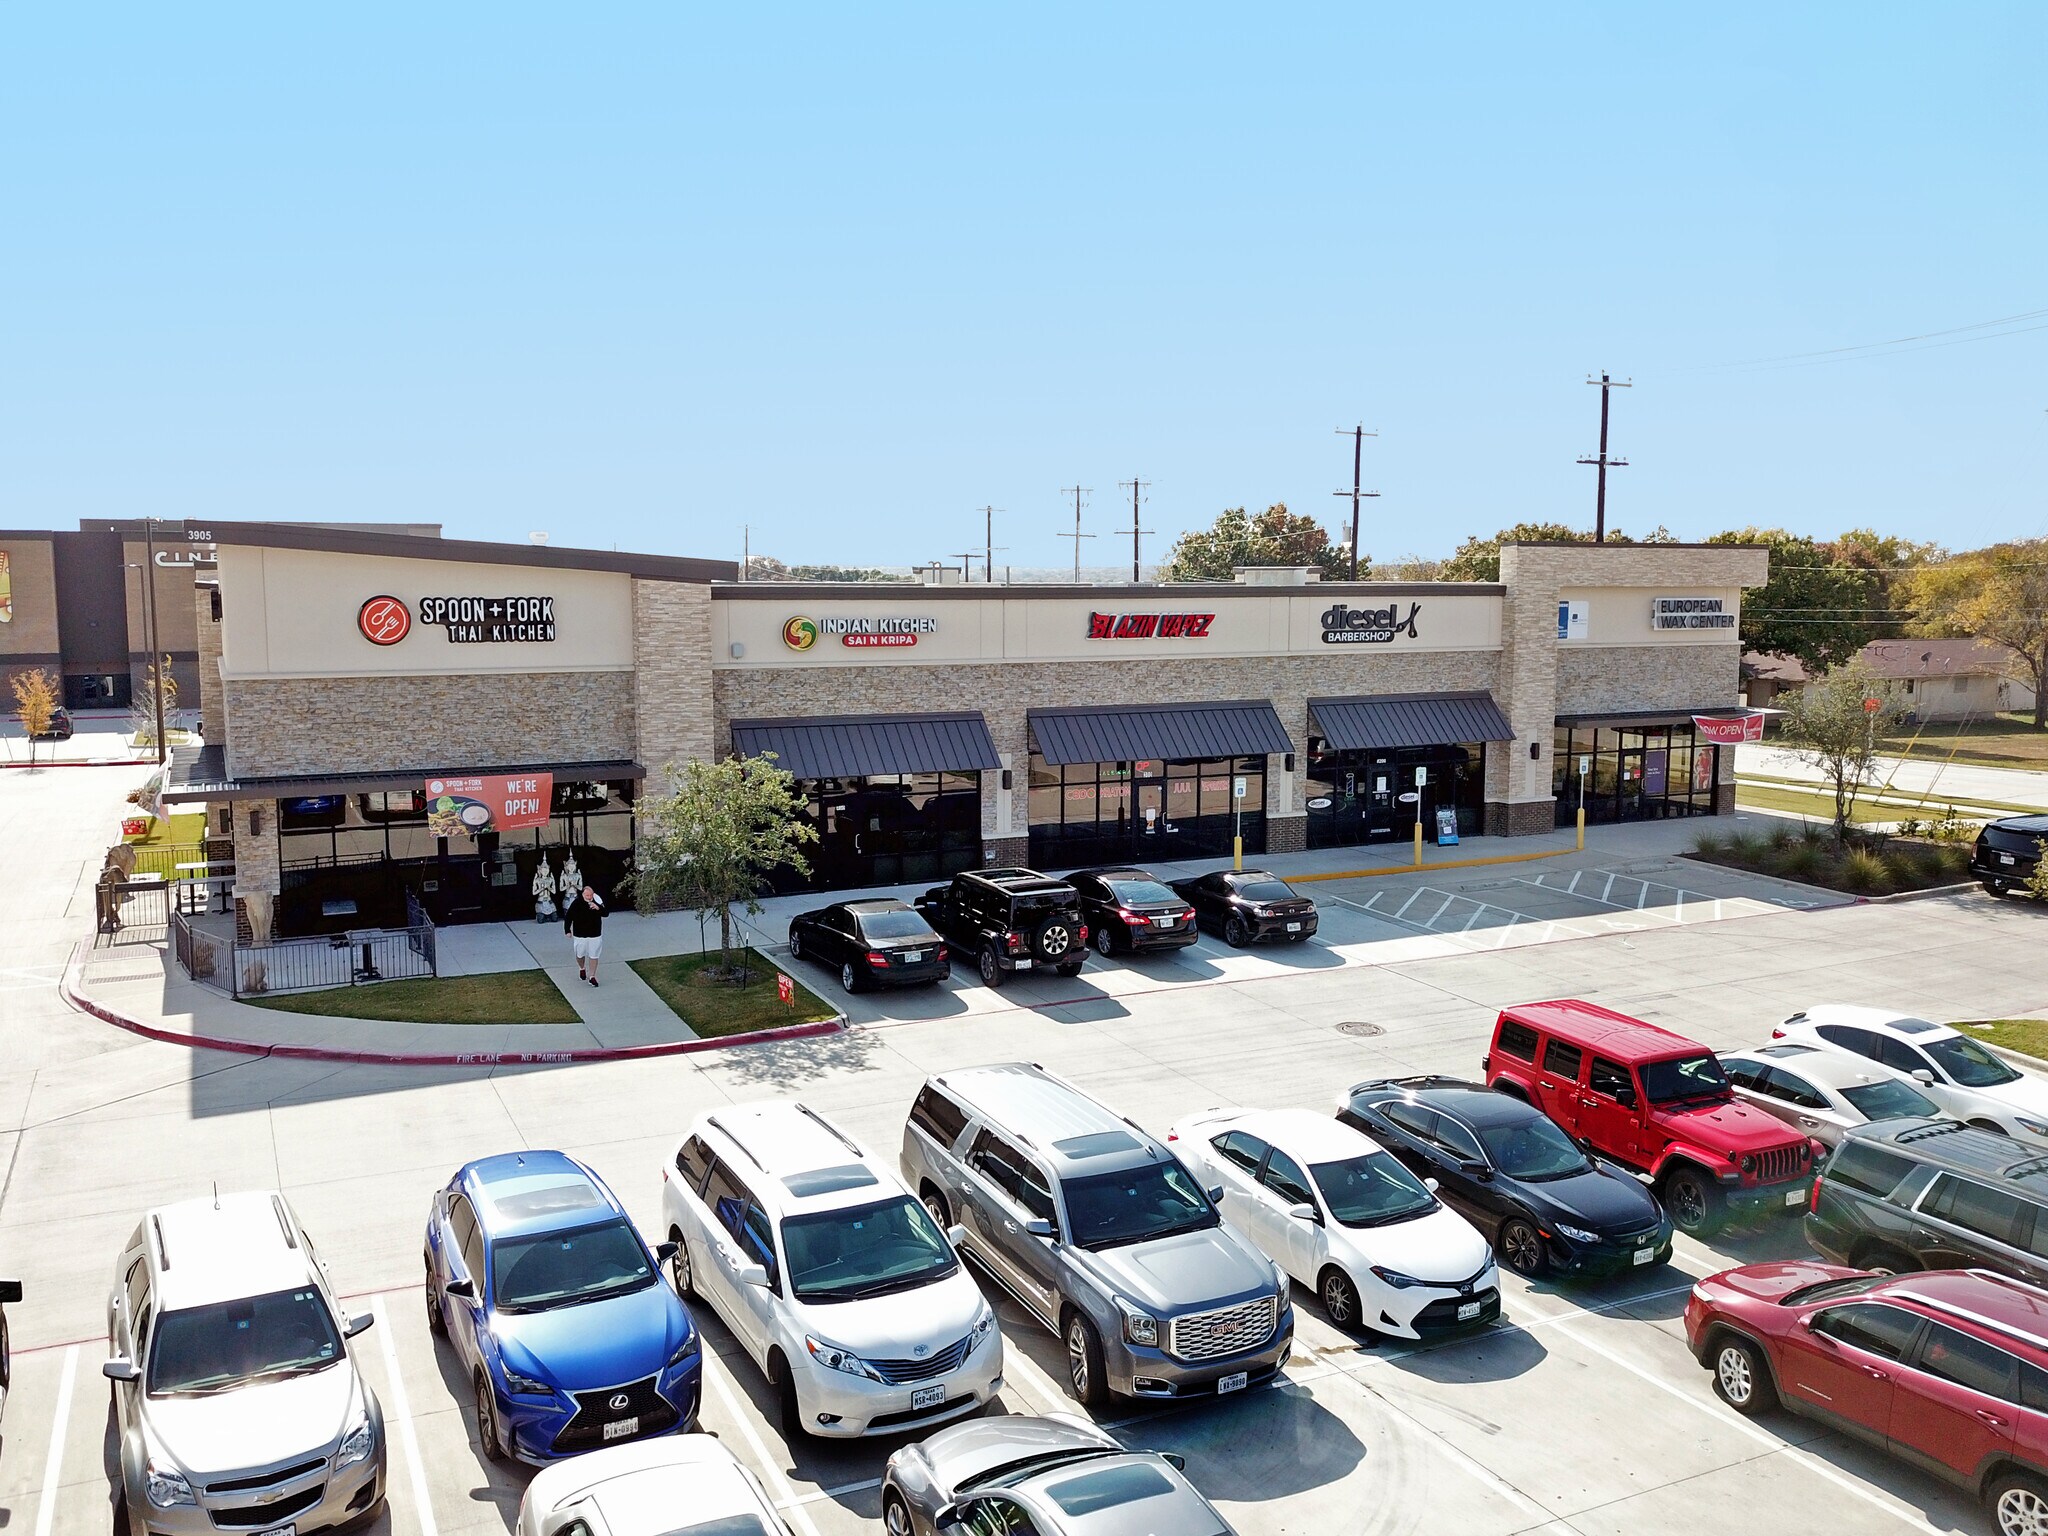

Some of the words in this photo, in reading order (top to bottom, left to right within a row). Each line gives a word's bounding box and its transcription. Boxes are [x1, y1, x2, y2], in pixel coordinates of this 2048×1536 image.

[188, 530, 212, 540] 3905
[423, 599, 485, 623] SPOON
[489, 603, 502, 617] +
[507, 599, 553, 622] FORK
[1660, 600, 1722, 613] EUROPEAN
[1321, 604, 1397, 629] diesel
[1660, 615, 1688, 628] WAX
[1691, 615, 1735, 628] CENTER
[821, 619, 872, 633] INDIAN
[878, 618, 937, 632] KITCHEN
[1089, 612, 1160, 639] BLAZIN
[1157, 614, 1216, 638] VAPEZ
[450, 625, 482, 641] THAI
[493, 624, 554, 640] KITCHEN
[1328, 631, 1391, 642] BARBERSHOP
[848, 636, 867, 645] SAI
[869, 635, 878, 645] N
[881, 635, 913, 644] KRIPA
[1719, 725, 1742, 735] OPEN
[507, 779, 536, 793] WE'RE
[505, 799, 539, 816] OPEN!
[457, 1054, 476, 1063] FIRE
[480, 1053, 502, 1062] LANE
[521, 1053, 532, 1061] NO
[537, 1052, 572, 1061] PARKING
[1211, 1321, 1246, 1335] GMC
